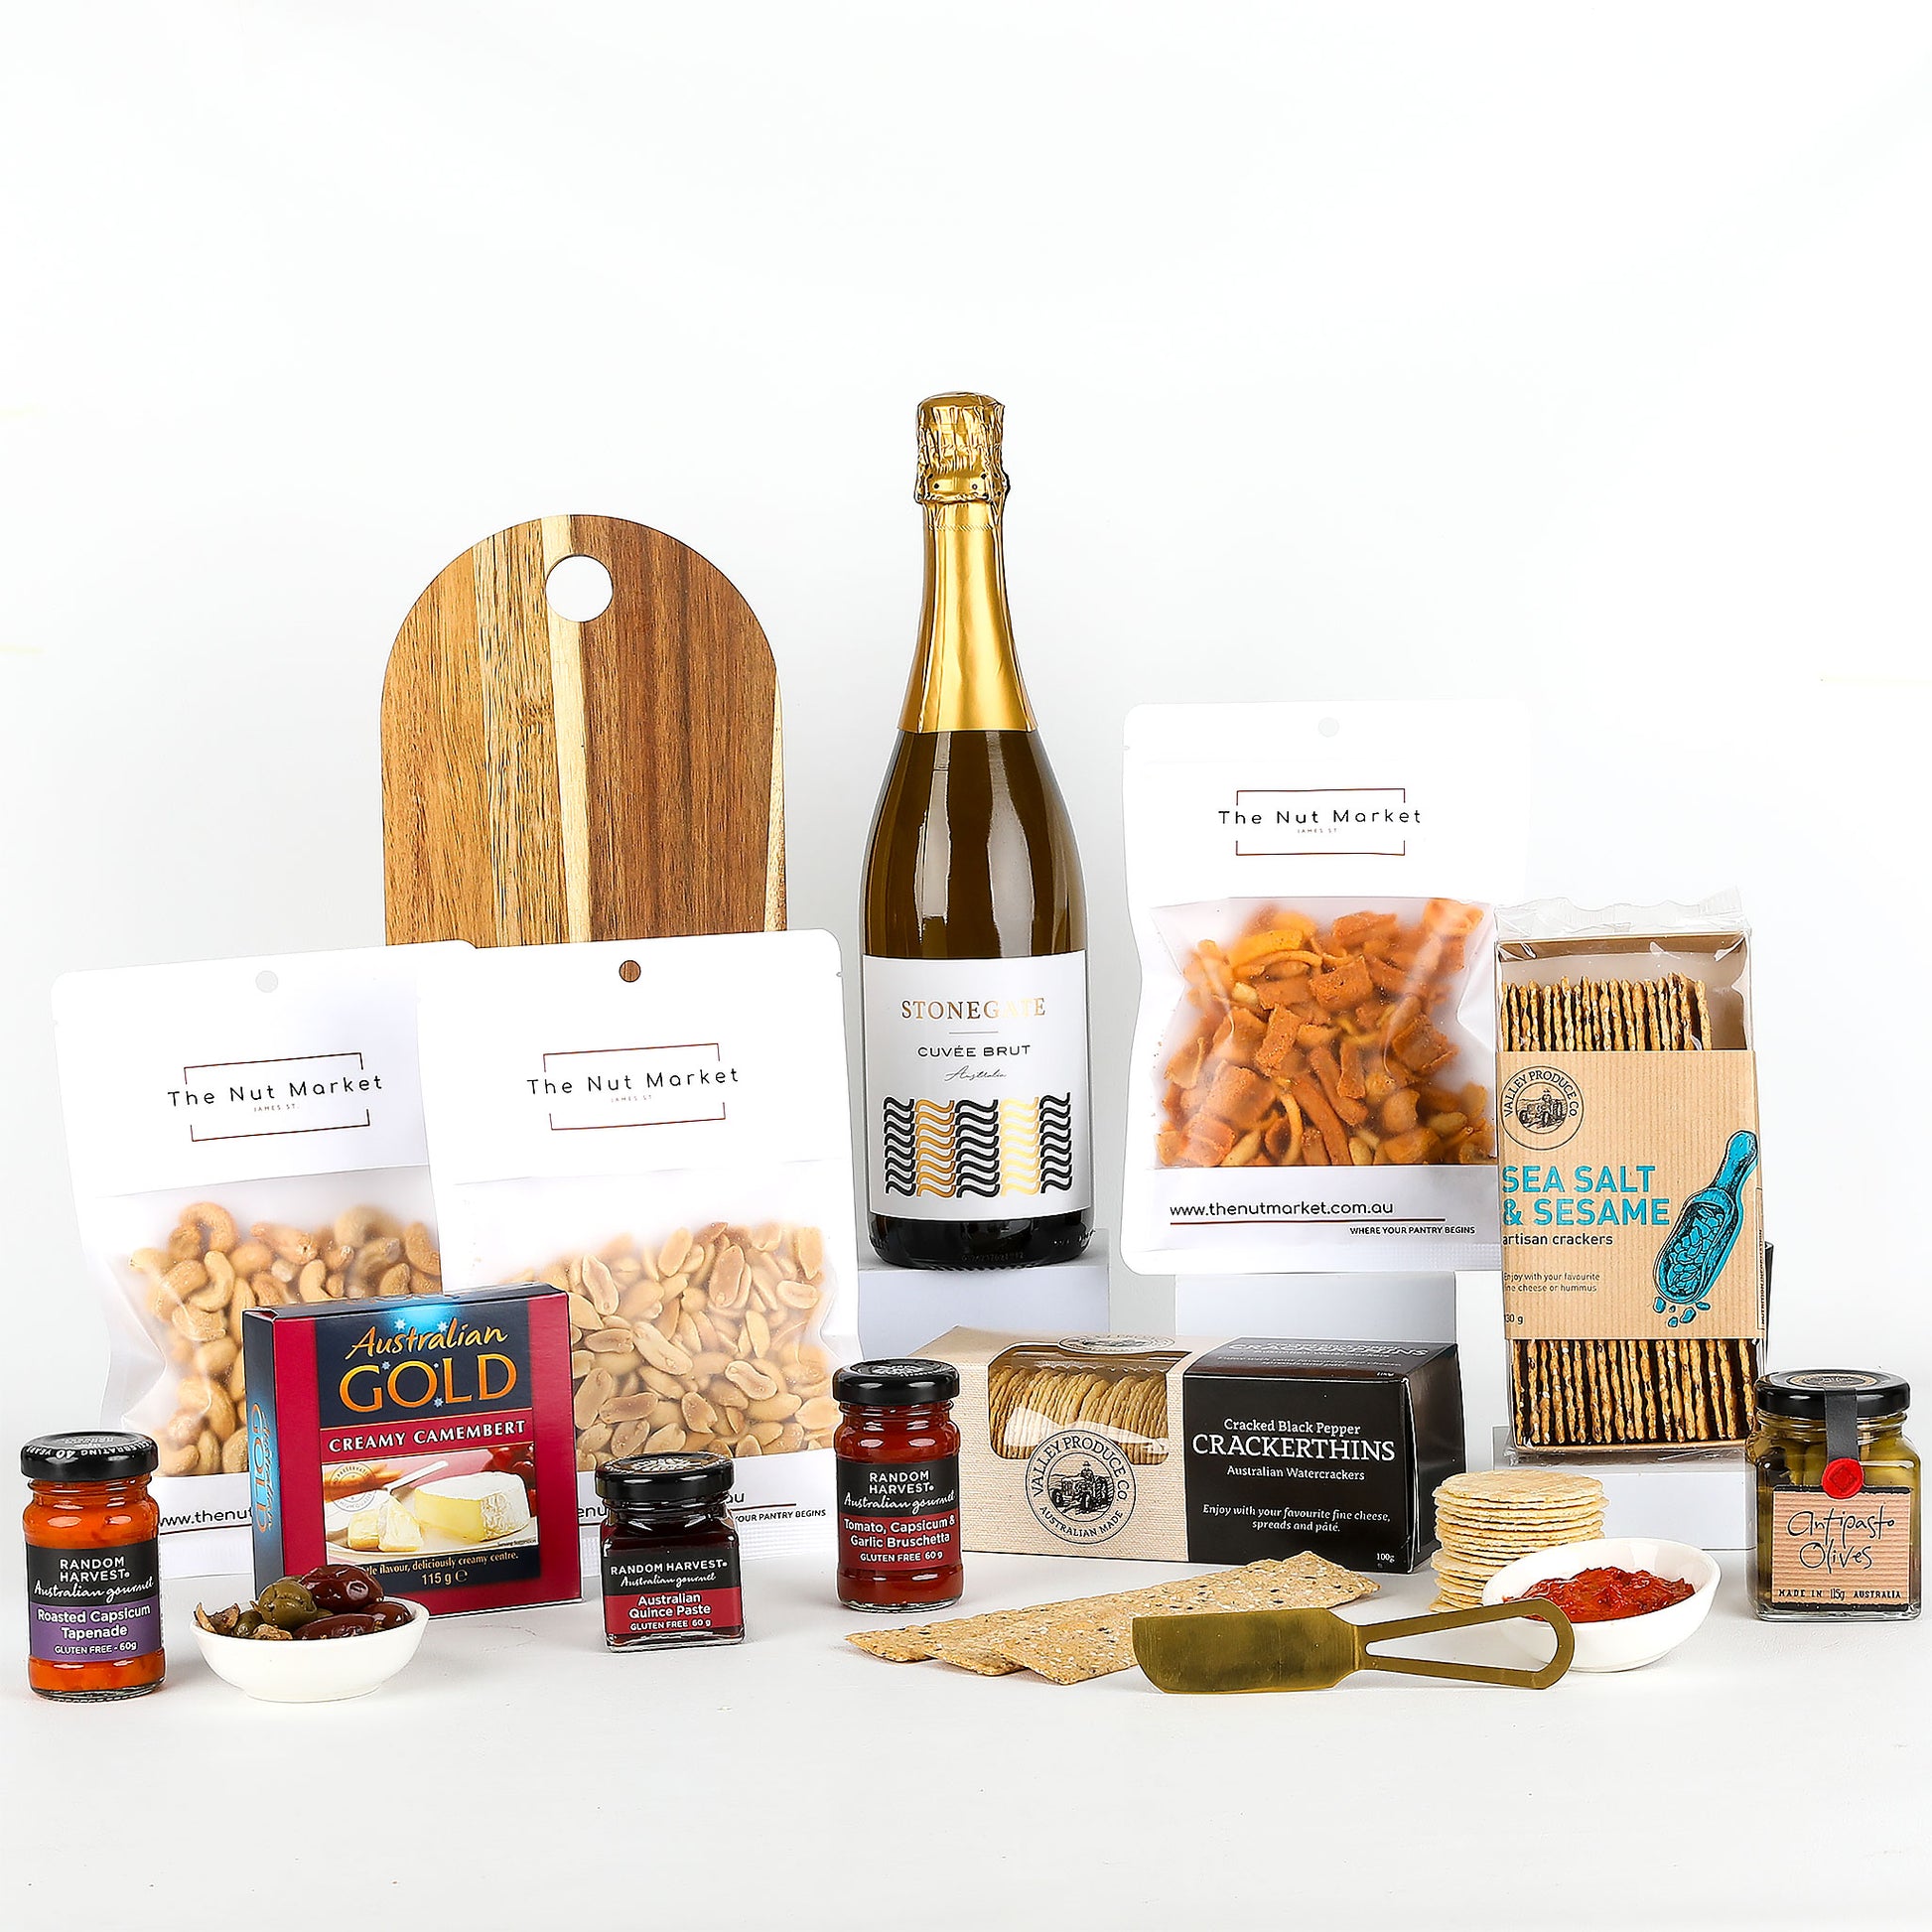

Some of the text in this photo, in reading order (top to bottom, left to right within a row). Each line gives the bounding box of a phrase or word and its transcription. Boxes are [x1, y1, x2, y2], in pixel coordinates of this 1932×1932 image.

[1218, 809, 1421, 824] The Nut Market
[901, 998, 1045, 1020] STONEGATE
[917, 1044, 1031, 1057] CUVÉE BRUT
[526, 1068, 739, 1094] The Nut Market
[168, 1074, 383, 1108] The Nut Market
[1504, 1074, 1528, 1118] VALLEY
[1528, 1070, 1577, 1100] PRODUCE
[1502, 1166, 1656, 1192] SEA SALT
[1170, 1201, 1394, 1216] www.thenutmarket.com.au
[1503, 1198, 1670, 1225] & SESAME
[1503, 1233, 1613, 1245] artisan crackers
[1524, 1272, 1543, 1281] with
[1544, 1274, 1562, 1283] your
[1564, 1272, 1600, 1281] favourite
[345, 1317, 509, 1360] Australian
[339, 1352, 517, 1413] GOLD
[1224, 1418, 1361, 1437] Cracked Black Pepper
[329, 1420, 526, 1452] CREAMY CAMEMBERT
[1192, 1434, 1395, 1461] CRACKERTHINS
[1032, 1440, 1061, 1497] VALLEY
[1062, 1436, 1126, 1477] PRODUCE
[1227, 1465, 1365, 1480] Australian Watercrackers
[870, 1470, 929, 1482] RANDOM
[844, 1489, 955, 1515] Australian gourmet
[759, 1511, 793, 1520] PANTRY
[795, 1509, 826, 1518] BEGINS
[1203, 1504, 1391, 1522] Enjoy with your favourite fine cheese,
[844, 1514, 955, 1534] Tomato, Capsicum &
[1039, 1506, 1123, 1537] AUSTRALIAN MADE
[1252, 1519, 1291, 1530] spreads
[1294, 1521, 1312, 1531] and
[851, 1533, 950, 1548] Garlic Bruschetta
[60, 1556, 124, 1570] RANDOM
[897, 1553, 921, 1562] FREE
[1376, 1553, 1395, 1563] 100g
[1799, 1539, 1872, 1574] Olives
[379, 1564, 411, 1575] flavour,
[412, 1556, 457, 1571] deliciously
[458, 1556, 488, 1567] creamy
[611, 1563, 663, 1576] RANDOM
[421, 1573, 452, 1586] 115 g
[621, 1573, 717, 1587] Australian gourmet
[34, 1576, 154, 1603] Australian gourmet
[1778, 1588, 1806, 1597] MADE
[637, 1592, 701, 1606] Australian
[38, 1605, 151, 1623] Roasted Capsicum
[628, 1604, 711, 1619] Quince Paste
[62, 1625, 128, 1641] Tapenade
[630, 1622, 664, 1631] GLUTEN
[55, 1645, 87, 1654] GLUTEN
[89, 1644, 112, 1653] FREE
[119, 1642, 137, 1652] 60g
